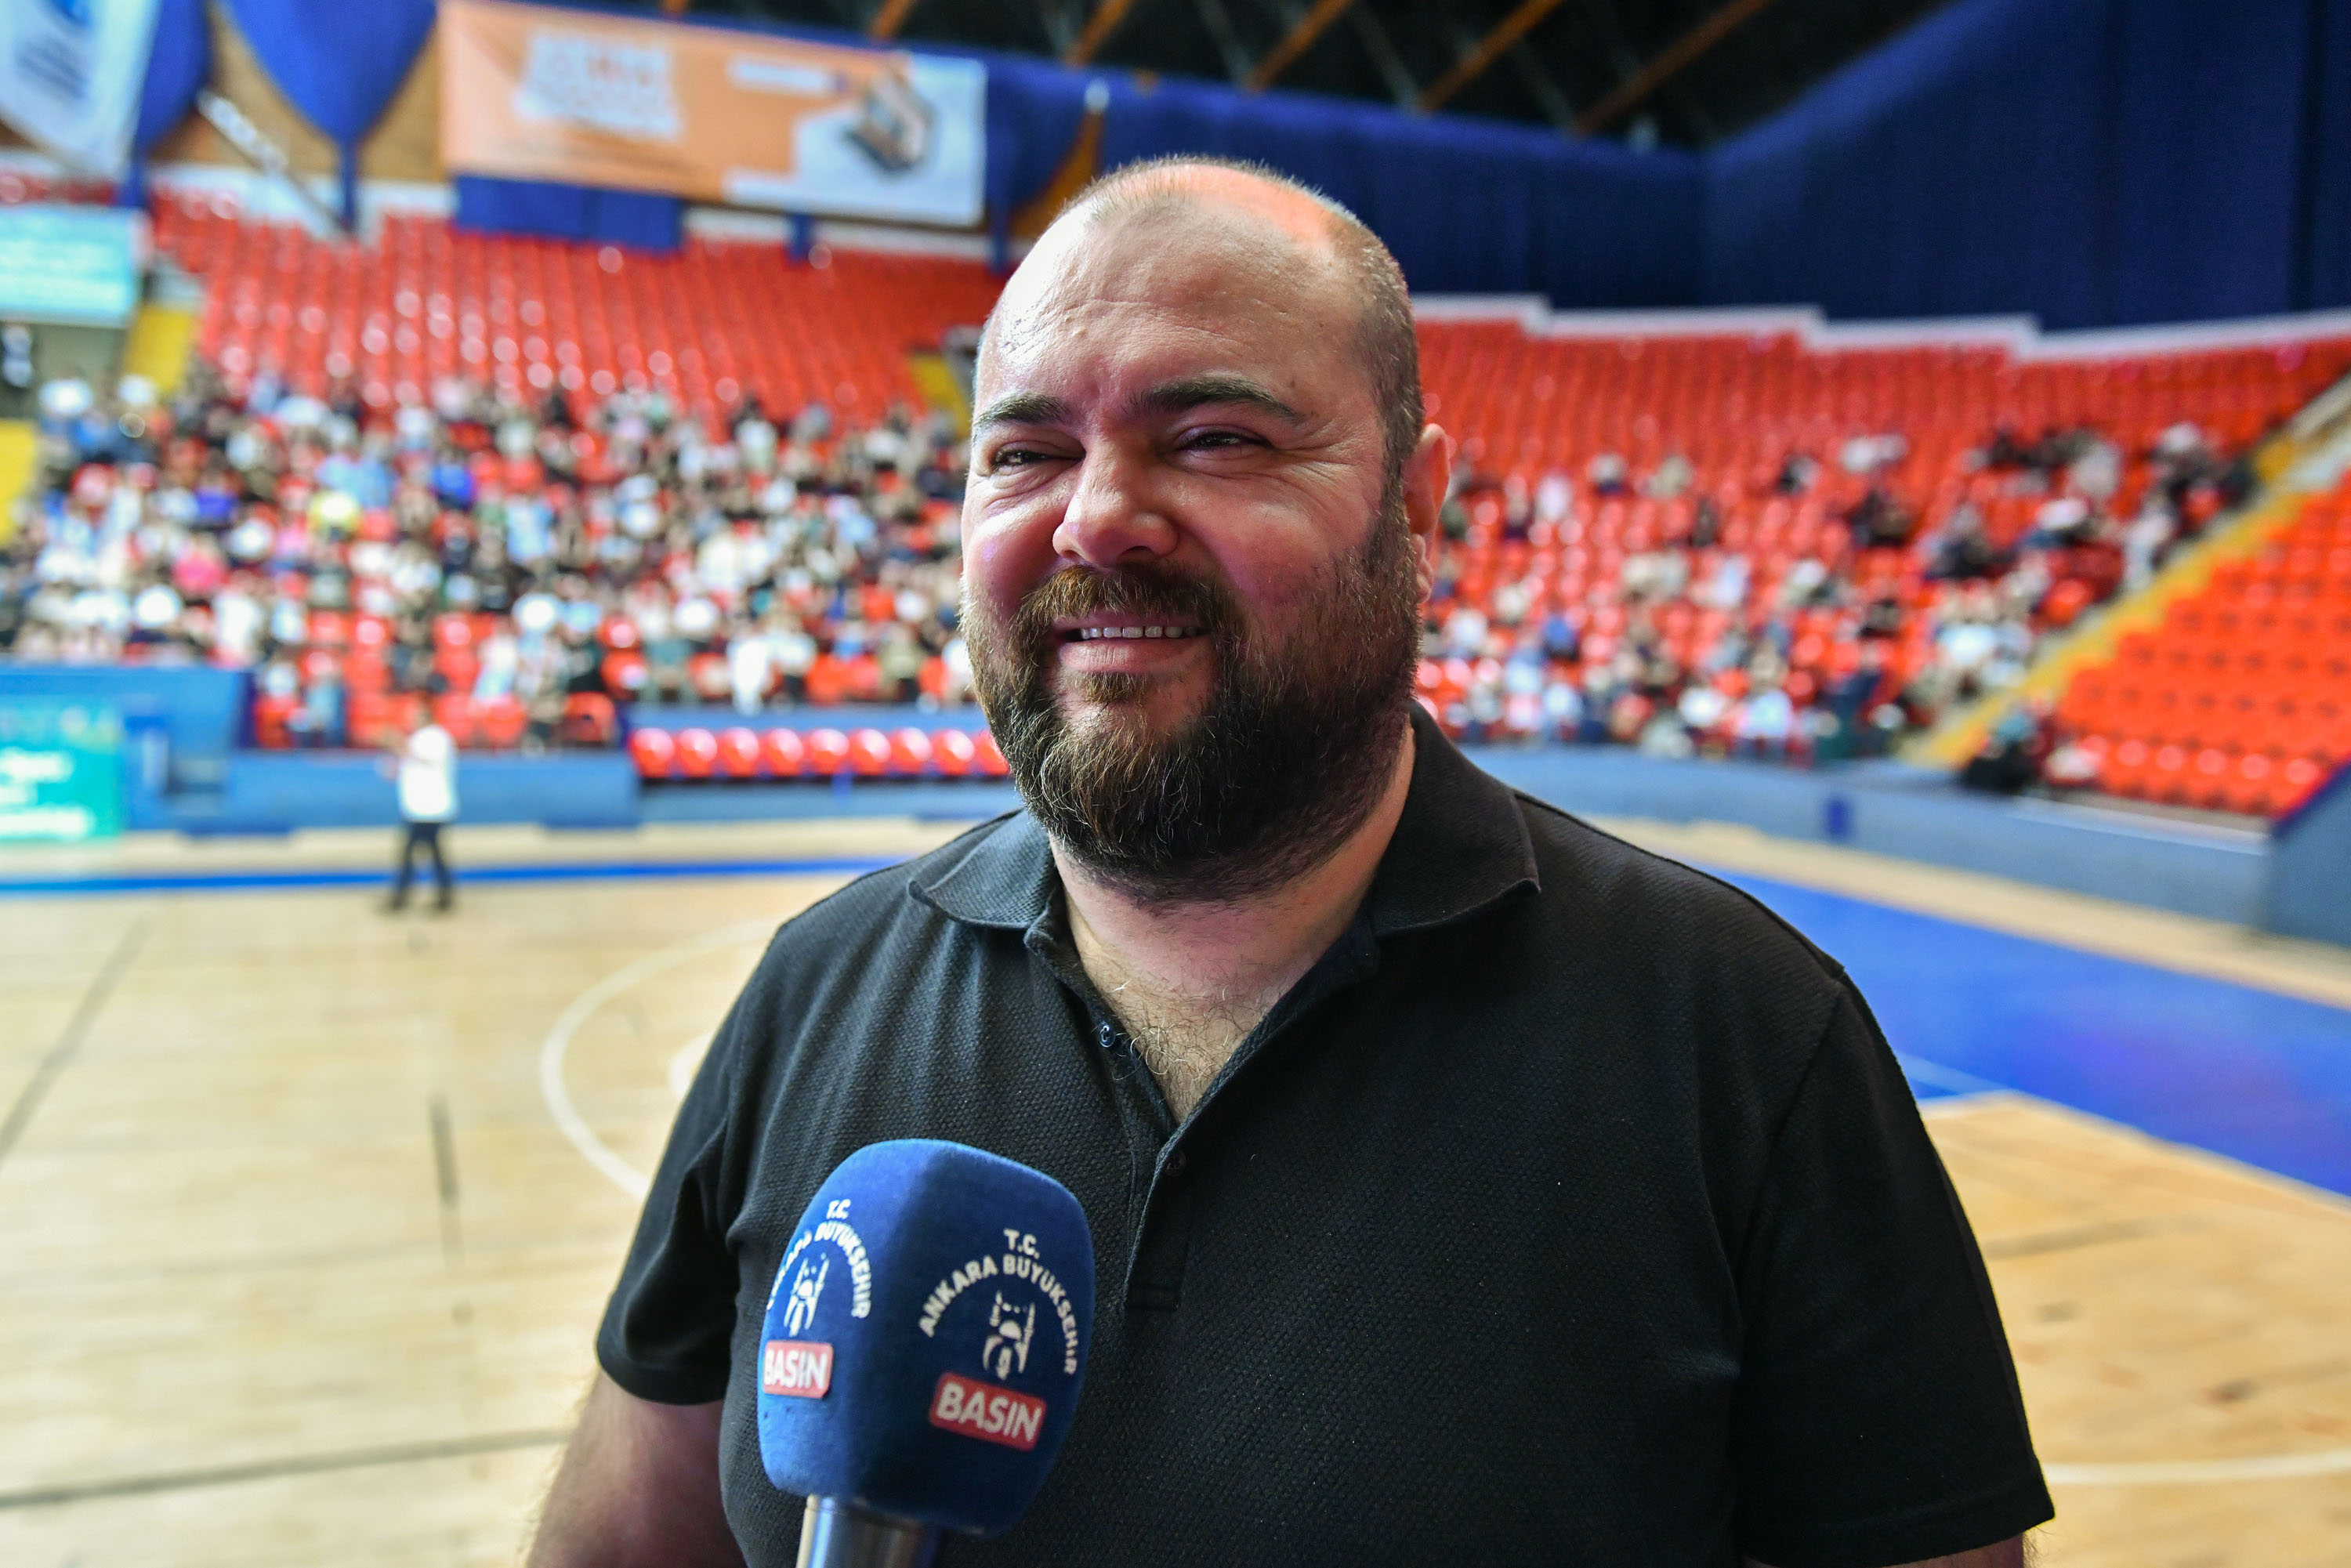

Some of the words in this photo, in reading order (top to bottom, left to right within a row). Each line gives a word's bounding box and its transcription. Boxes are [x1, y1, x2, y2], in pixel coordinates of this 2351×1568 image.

[1003, 1228, 1040, 1259] T.C.
[918, 1255, 1000, 1338] ANKARA
[763, 1349, 828, 1389] BASIN
[936, 1382, 1042, 1442] BASIN
